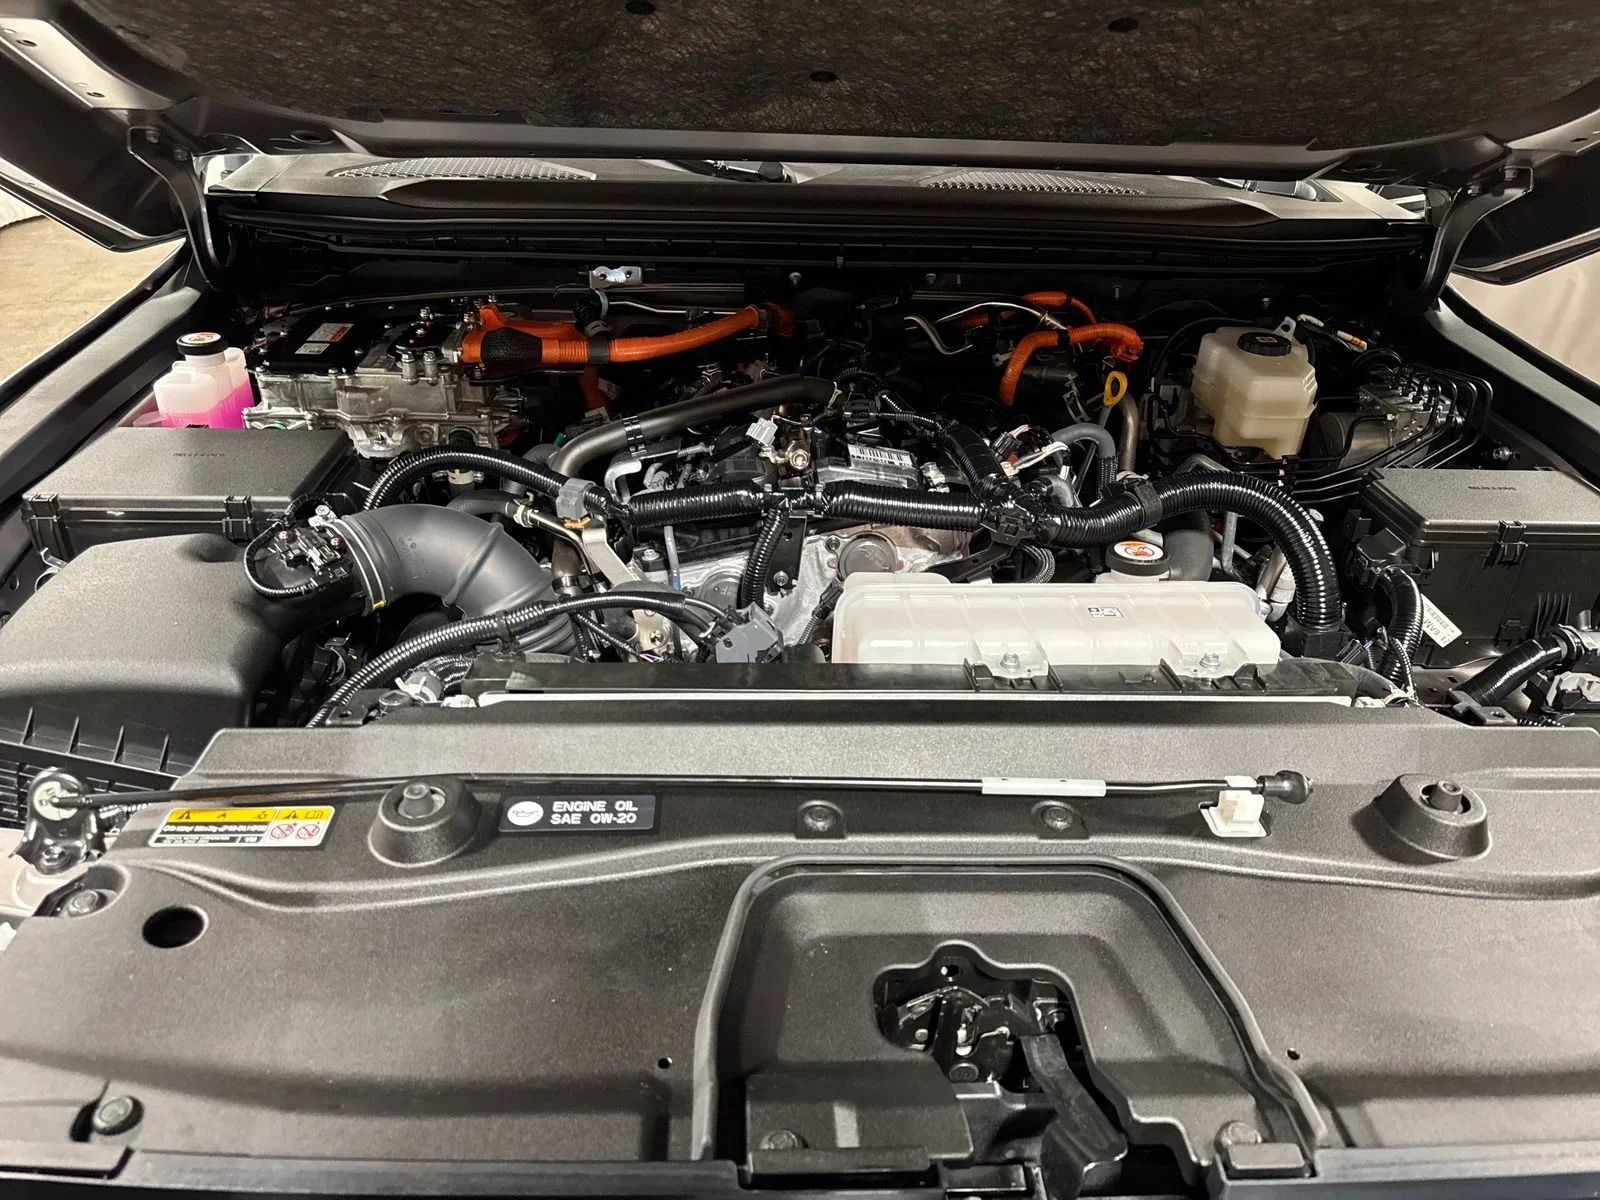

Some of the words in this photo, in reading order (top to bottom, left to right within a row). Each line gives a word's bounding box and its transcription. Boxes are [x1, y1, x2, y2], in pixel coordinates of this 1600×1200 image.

[552, 800, 607, 812] ENGINE
[614, 800, 639, 811] OIL
[550, 813, 582, 824] SAE
[590, 812, 637, 824] 0W-20
